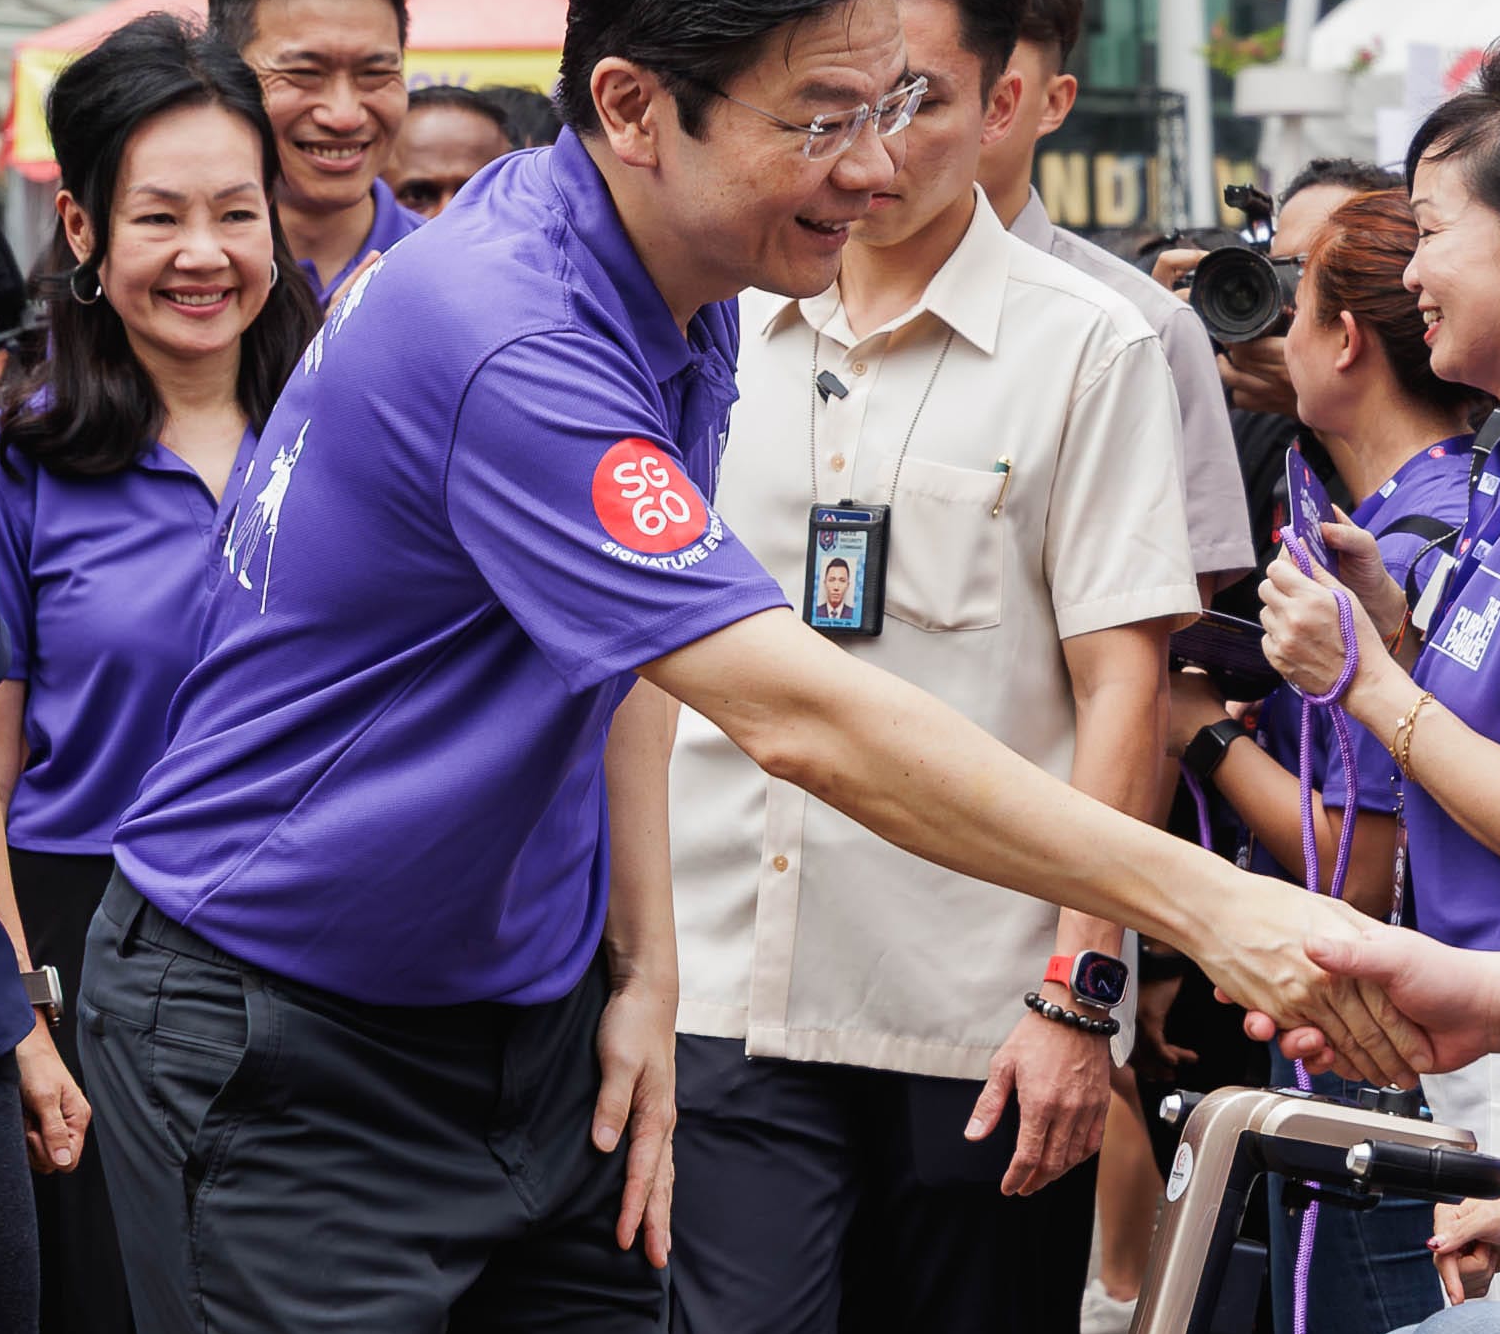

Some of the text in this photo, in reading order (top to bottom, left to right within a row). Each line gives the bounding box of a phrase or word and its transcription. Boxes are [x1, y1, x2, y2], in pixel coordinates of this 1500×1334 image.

[612, 456, 670, 499] SG
[631, 489, 691, 537] 60
[600, 540, 709, 571] SIGNATURE
[1451, 605, 1494, 642] PURPLE
[1441, 627, 1486, 666] PARADE
